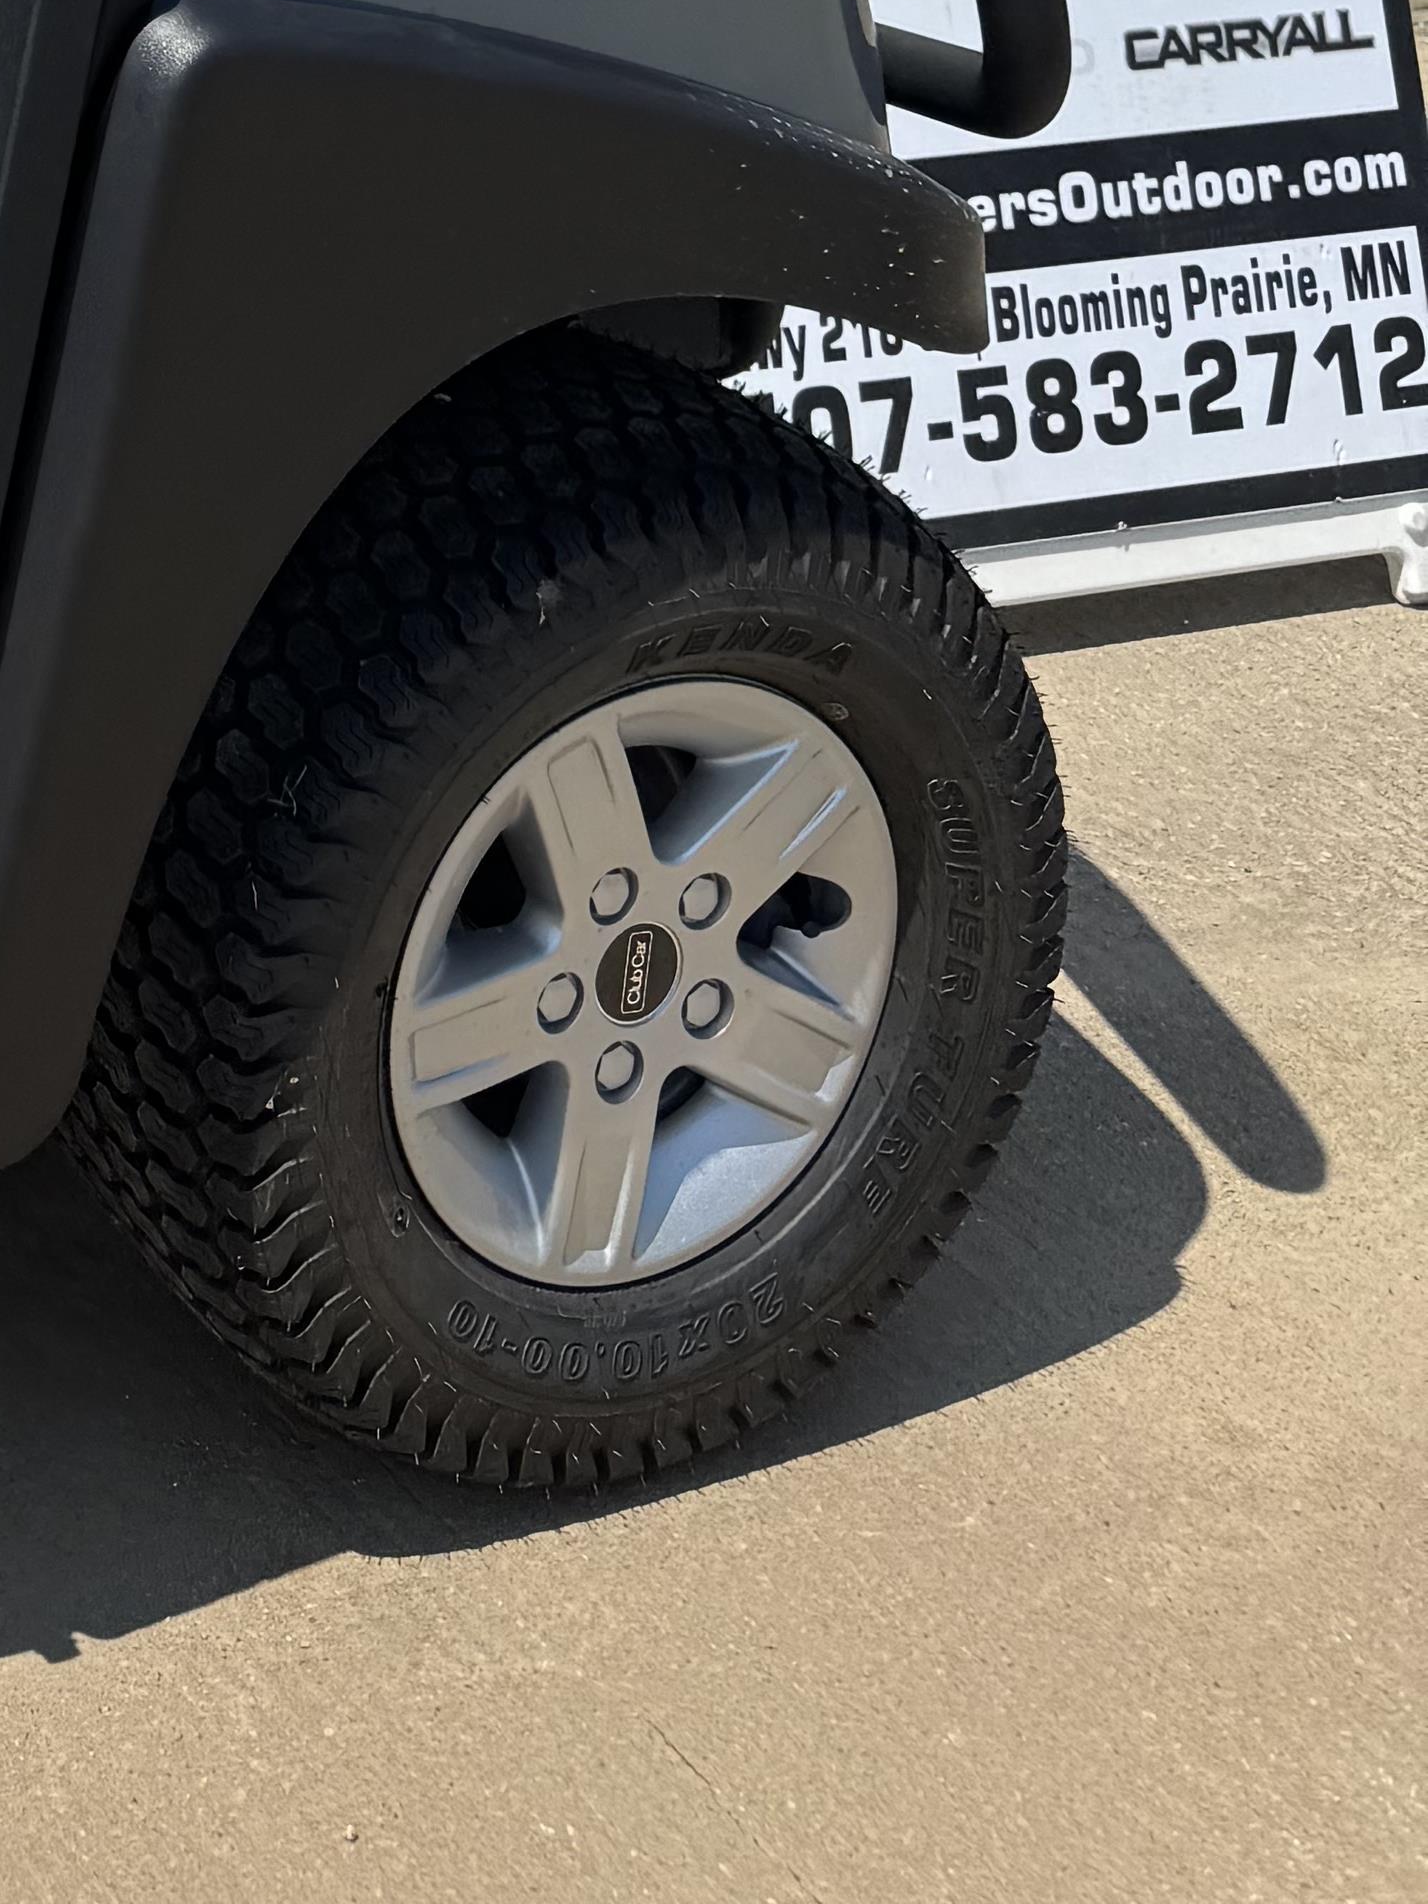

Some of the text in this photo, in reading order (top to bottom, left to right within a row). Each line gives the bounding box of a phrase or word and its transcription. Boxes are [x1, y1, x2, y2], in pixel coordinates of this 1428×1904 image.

[1123, 8, 1375, 70] CARRYALL
[968, 151, 1407, 233] ersOutdoor.com
[991, 273, 1172, 342] Blooming
[1181, 254, 1332, 320] Prairie,
[1340, 240, 1412, 301] MN
[791, 316, 1428, 474] 07-583-2712
[626, 621, 853, 676] KENDA
[926, 778, 985, 1004] SUPER
[627, 940, 647, 1005] Club Car
